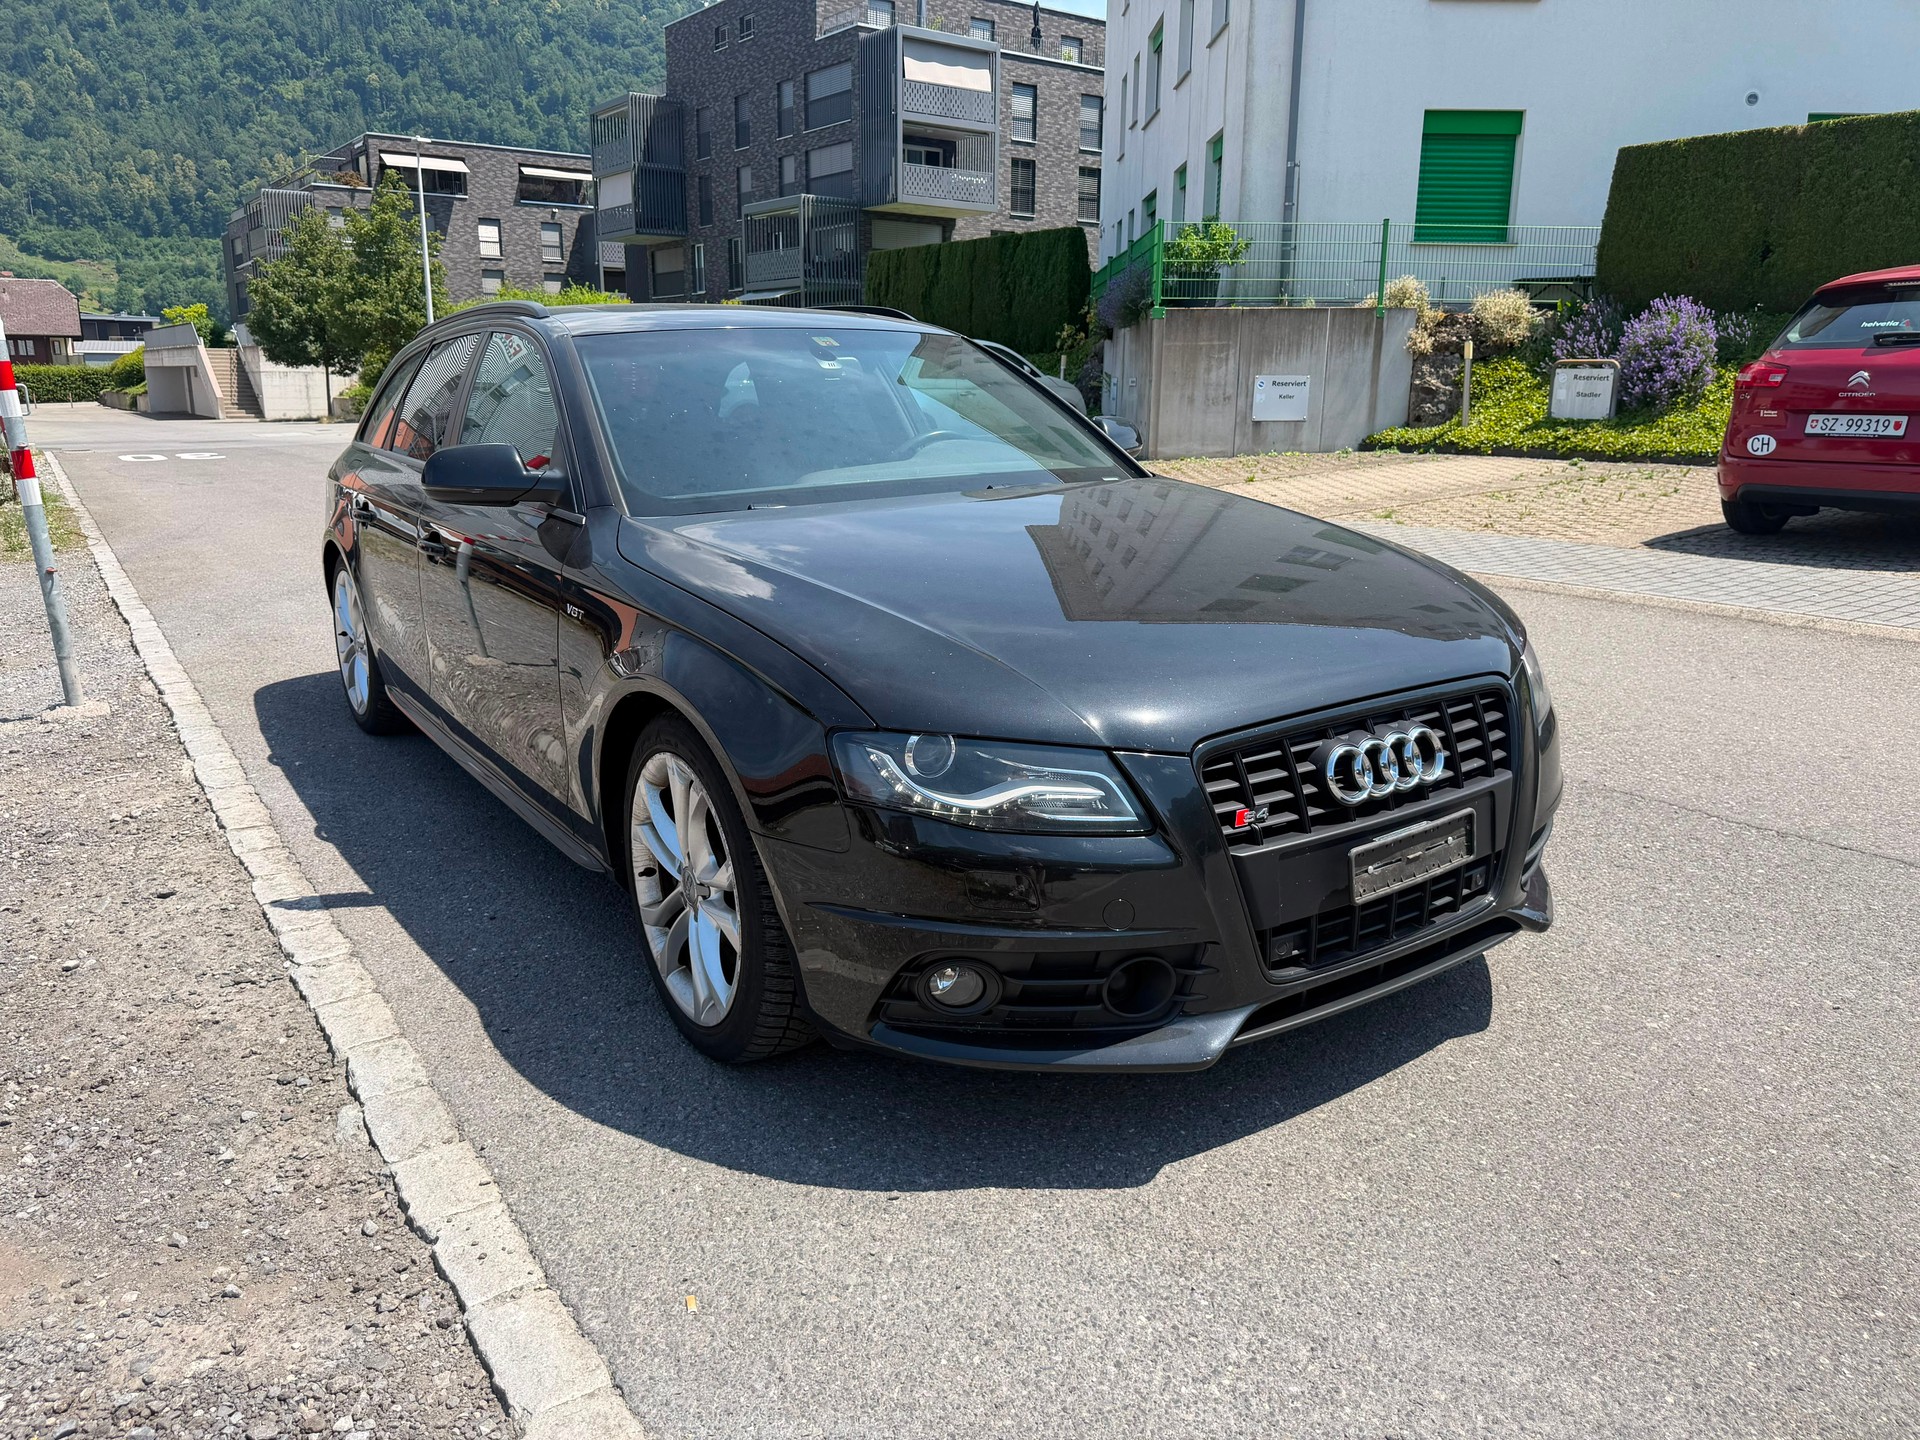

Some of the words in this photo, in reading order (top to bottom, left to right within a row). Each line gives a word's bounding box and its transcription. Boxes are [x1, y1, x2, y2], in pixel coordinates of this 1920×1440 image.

[1860, 320, 1900, 328] helvetia
[1750, 437, 1770, 453] CH
[1241, 807, 1269, 823] S4
